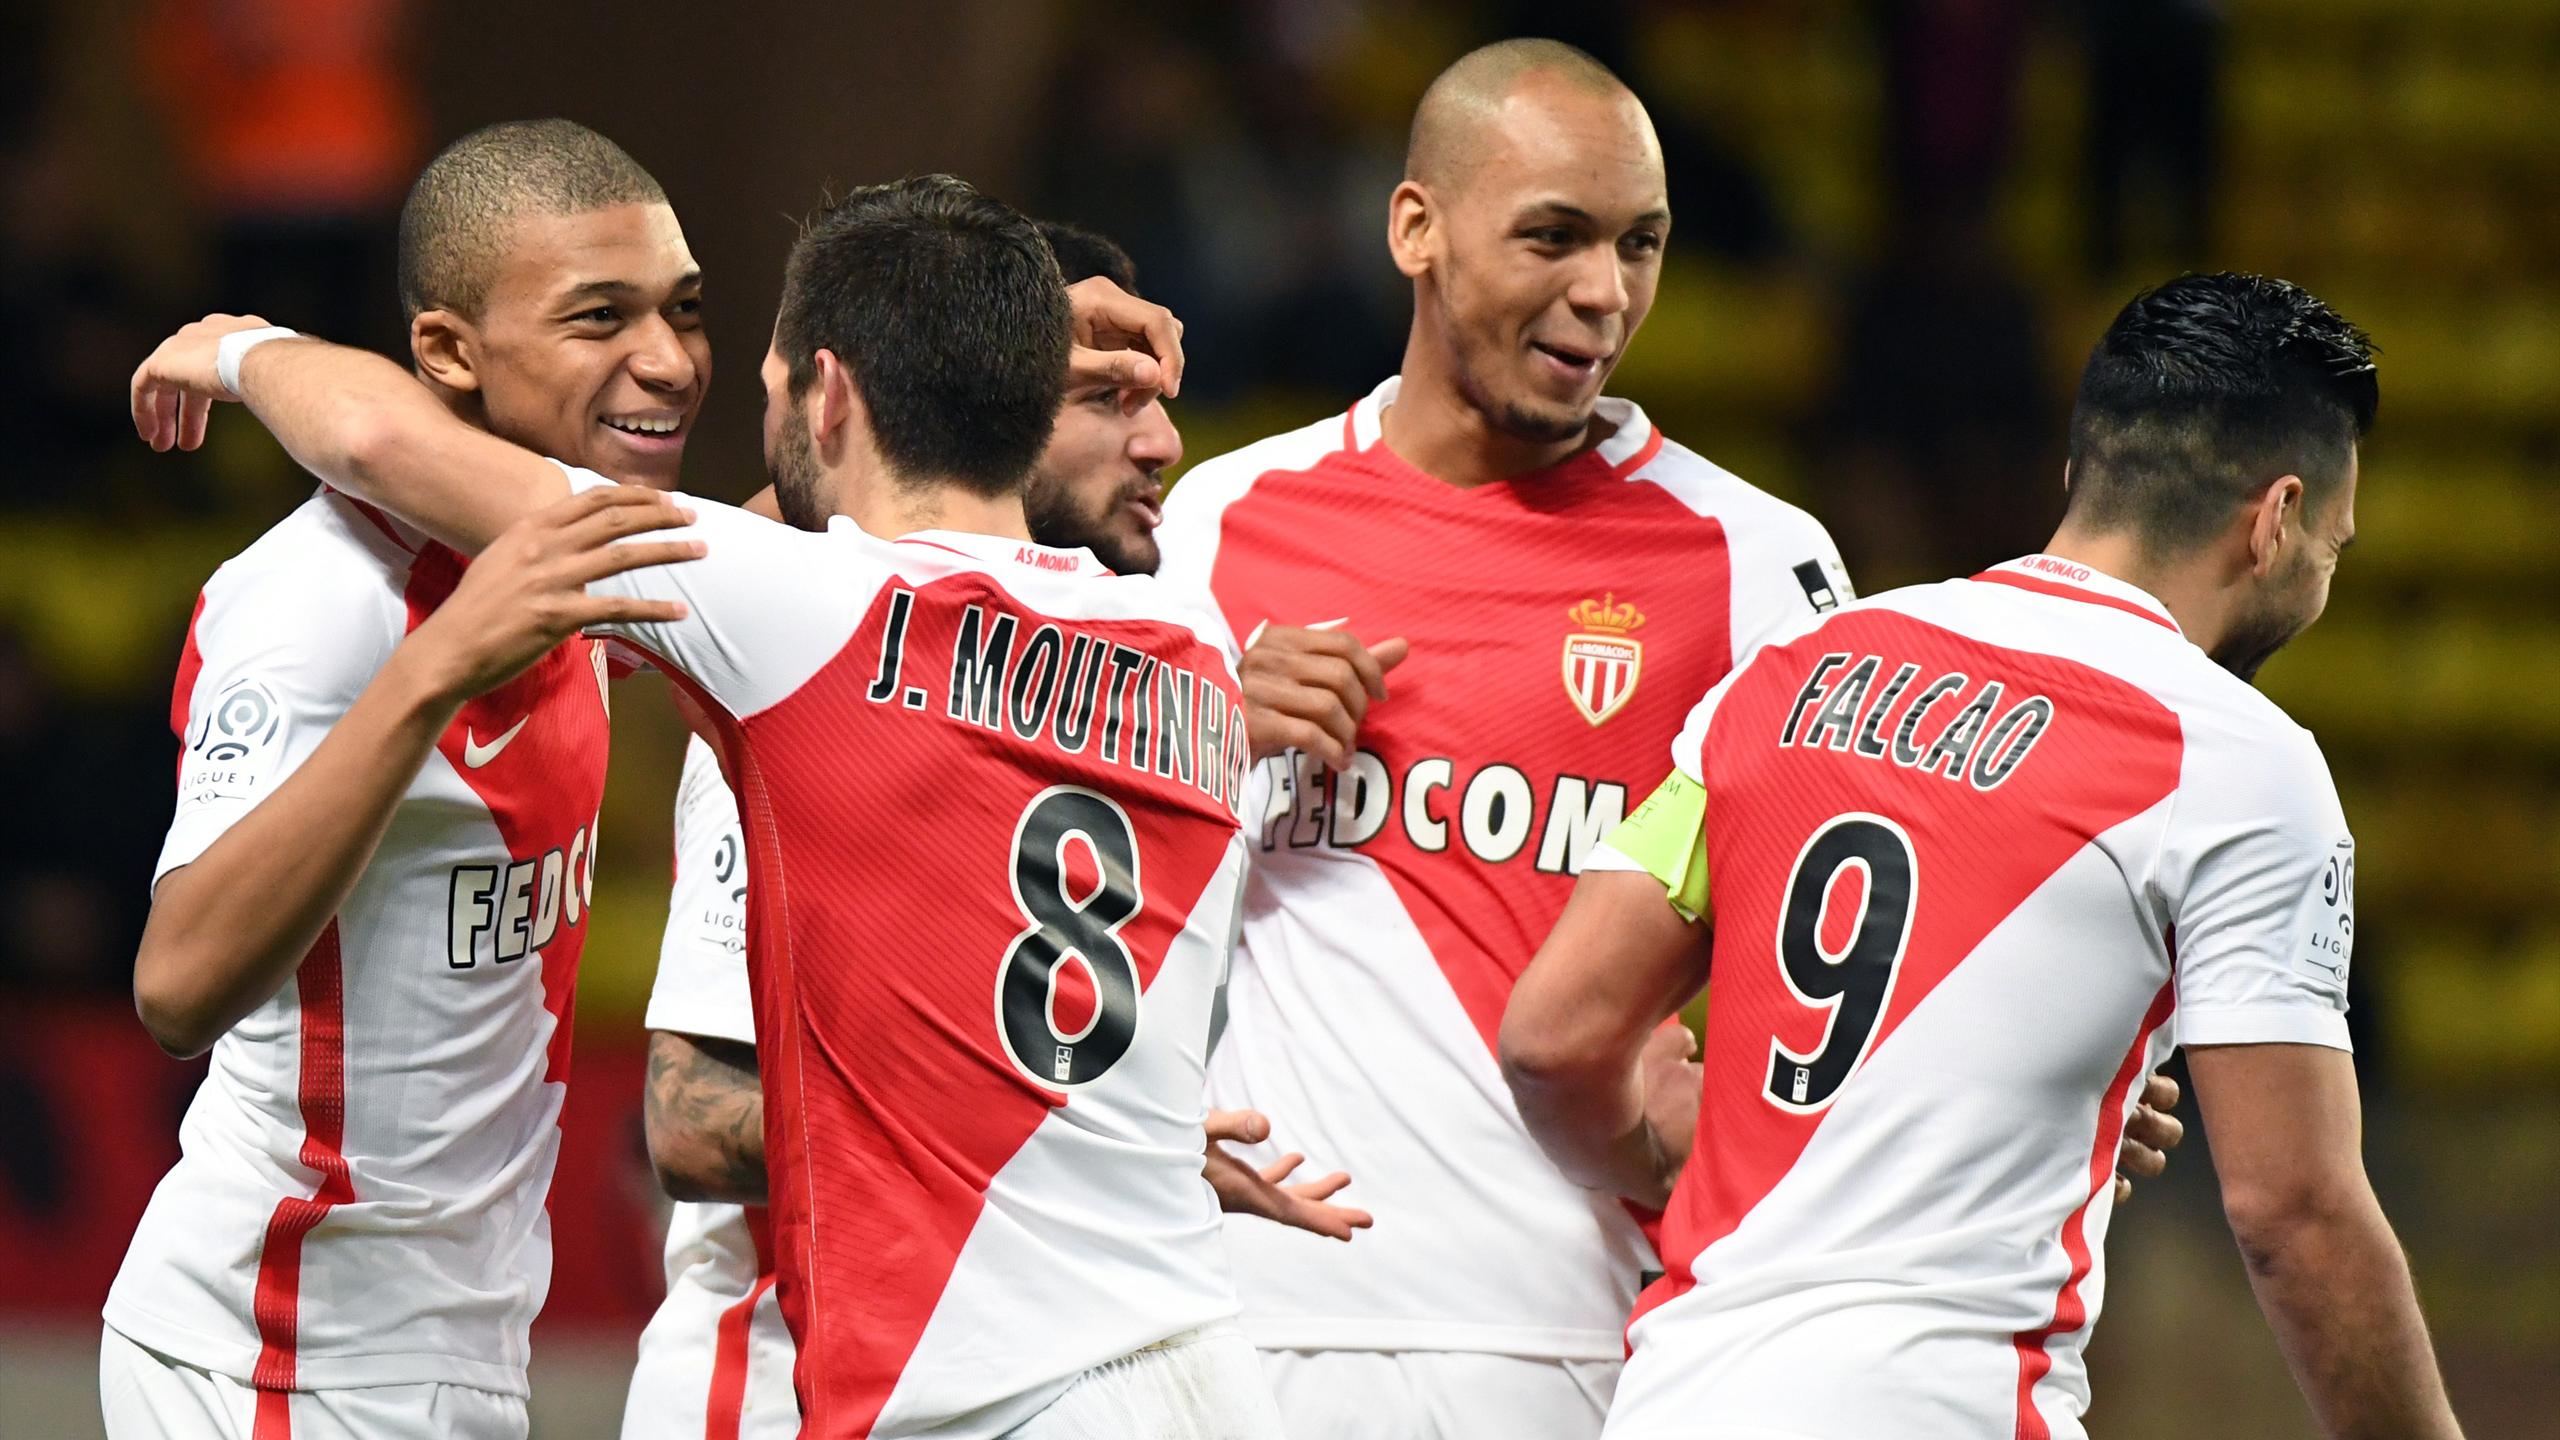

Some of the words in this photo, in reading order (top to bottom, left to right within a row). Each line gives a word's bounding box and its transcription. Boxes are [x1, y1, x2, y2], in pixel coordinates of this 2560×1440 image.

[1014, 547, 1034, 565] AS
[1035, 552, 1079, 572] MONACO
[2019, 556, 2037, 568] AS
[2034, 558, 2091, 582] MONACO
[866, 588, 928, 711] J.
[947, 604, 1250, 819] MOUTINHO
[1779, 651, 2053, 791] FALCAO
[1262, 749, 1627, 876] FEDCOM
[994, 784, 1143, 1094] 8
[1762, 811, 1919, 1114] 9
